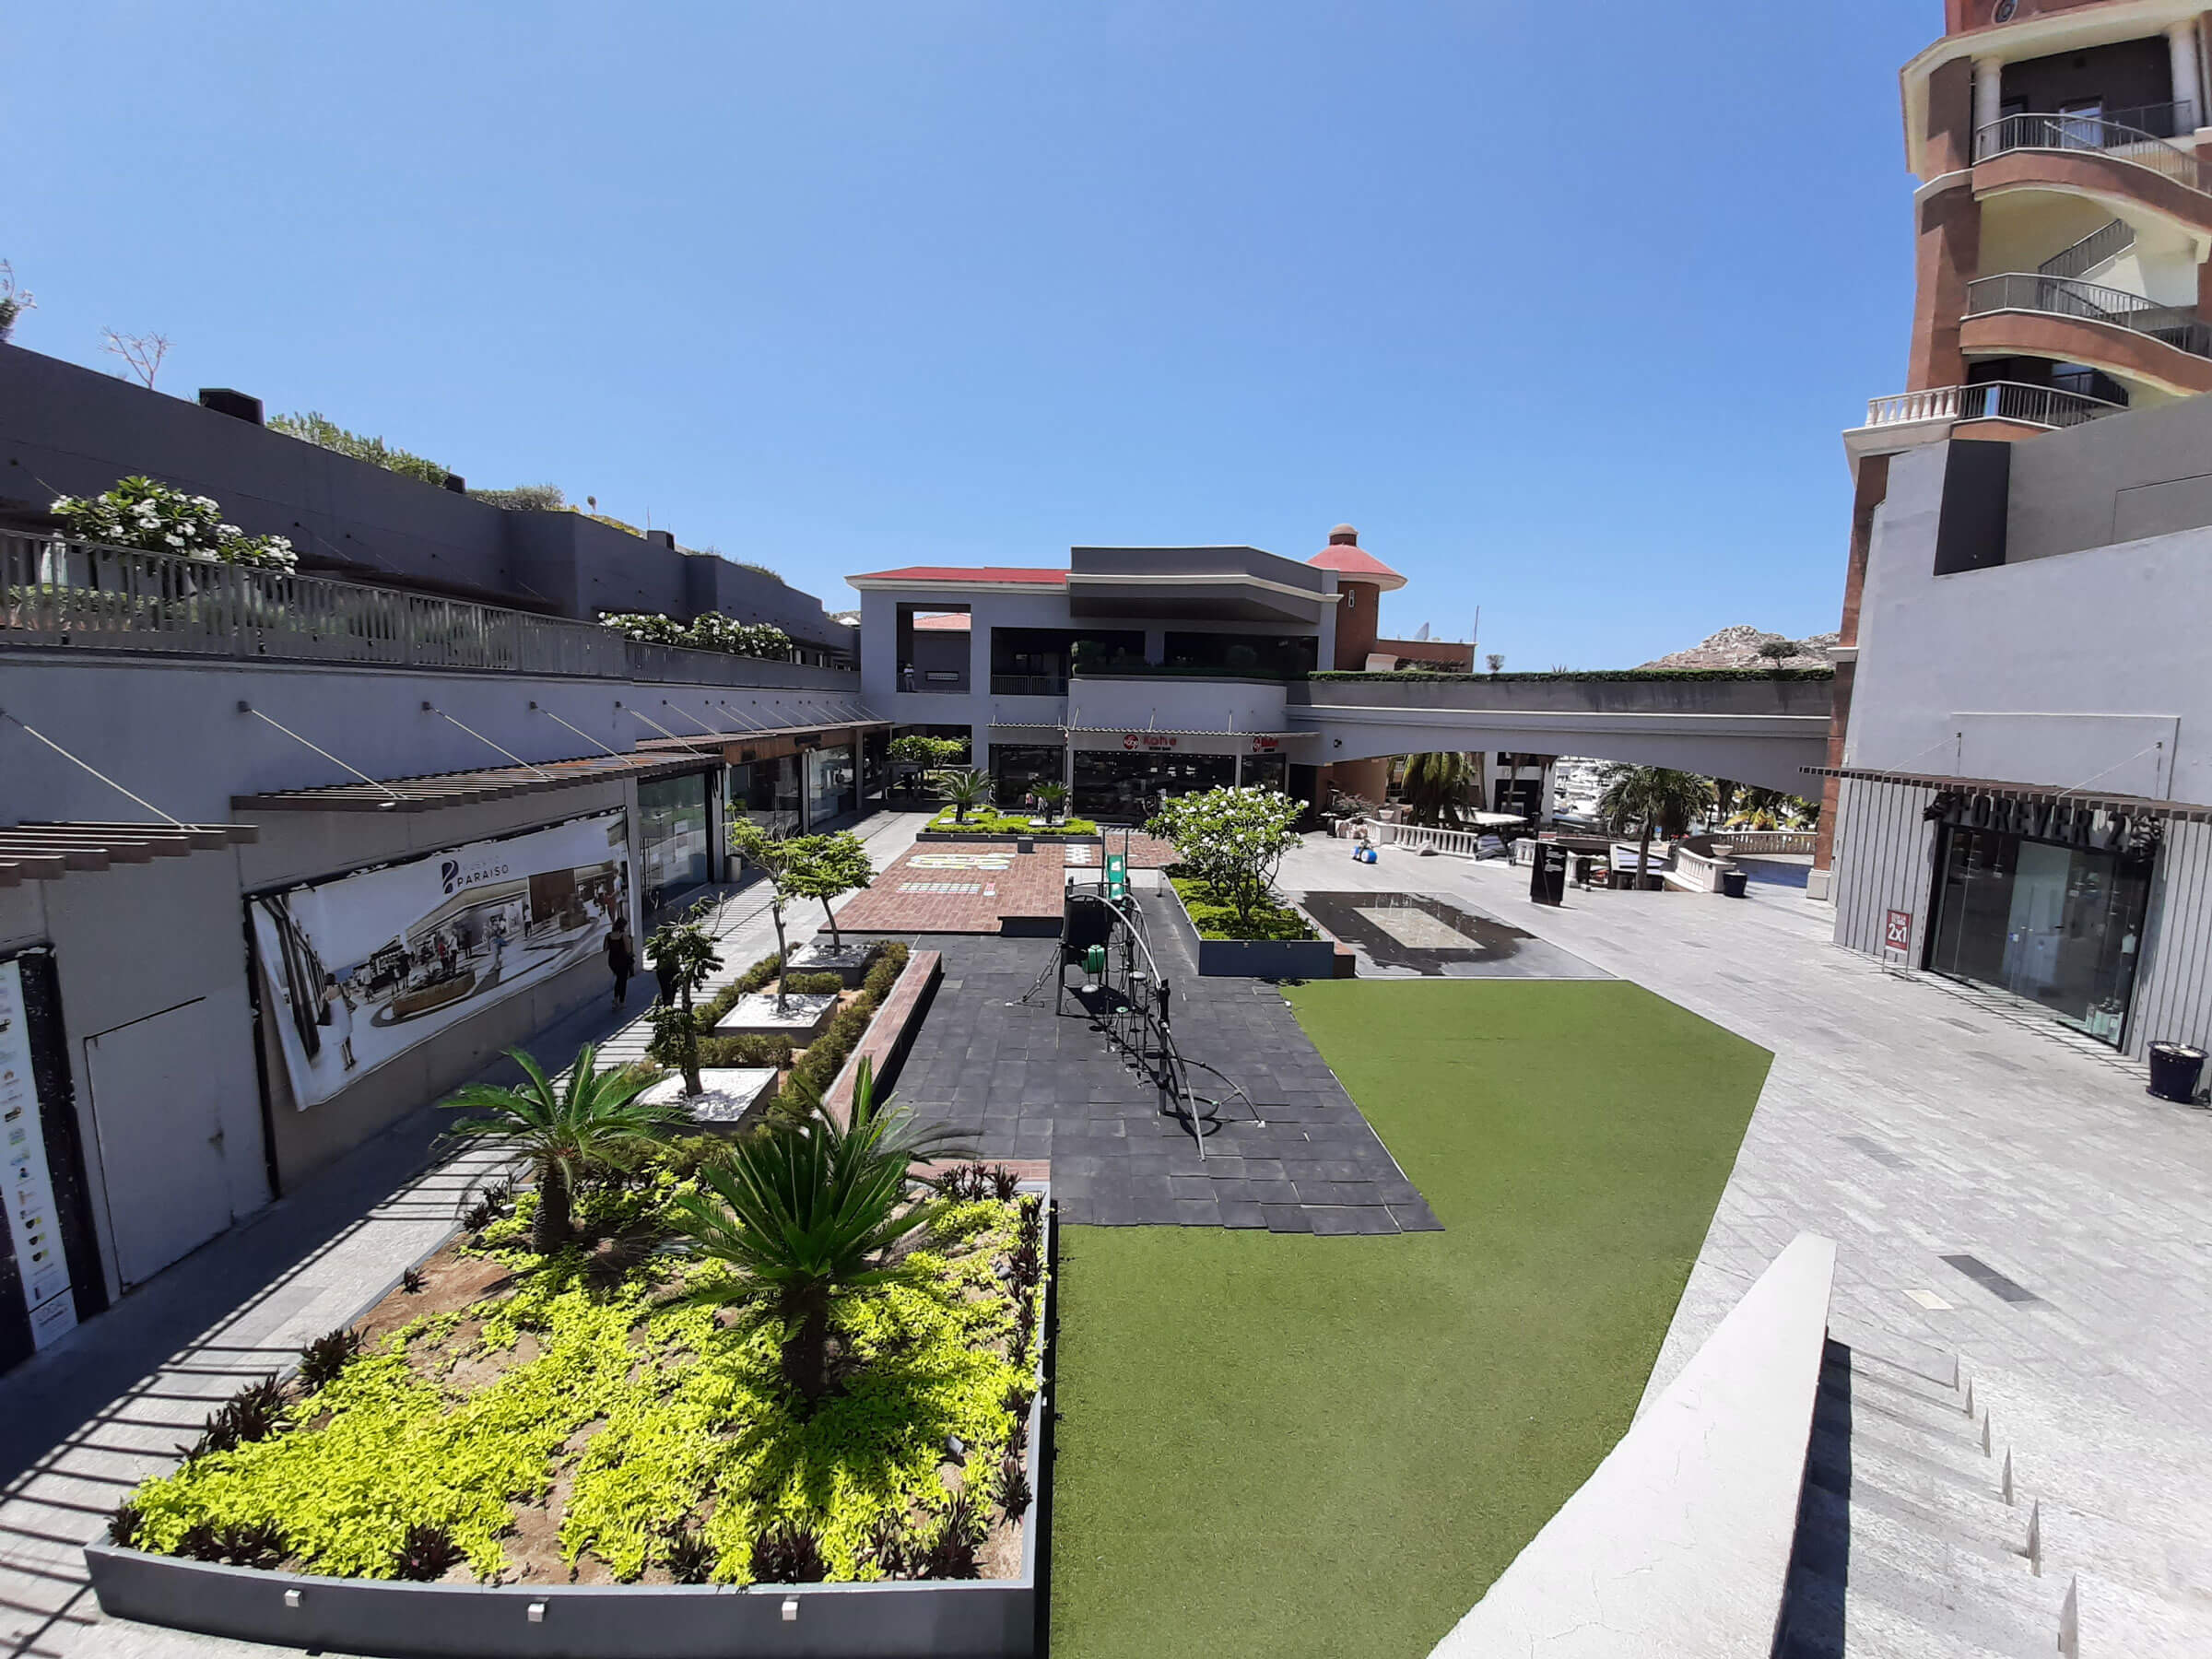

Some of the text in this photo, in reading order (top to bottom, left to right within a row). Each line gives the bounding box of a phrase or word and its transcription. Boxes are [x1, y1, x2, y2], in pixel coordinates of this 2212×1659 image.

[1952, 793, 2092, 845] FOREVER
[456, 864, 510, 888] PARAISO
[1888, 922, 1907, 944] 2x1
